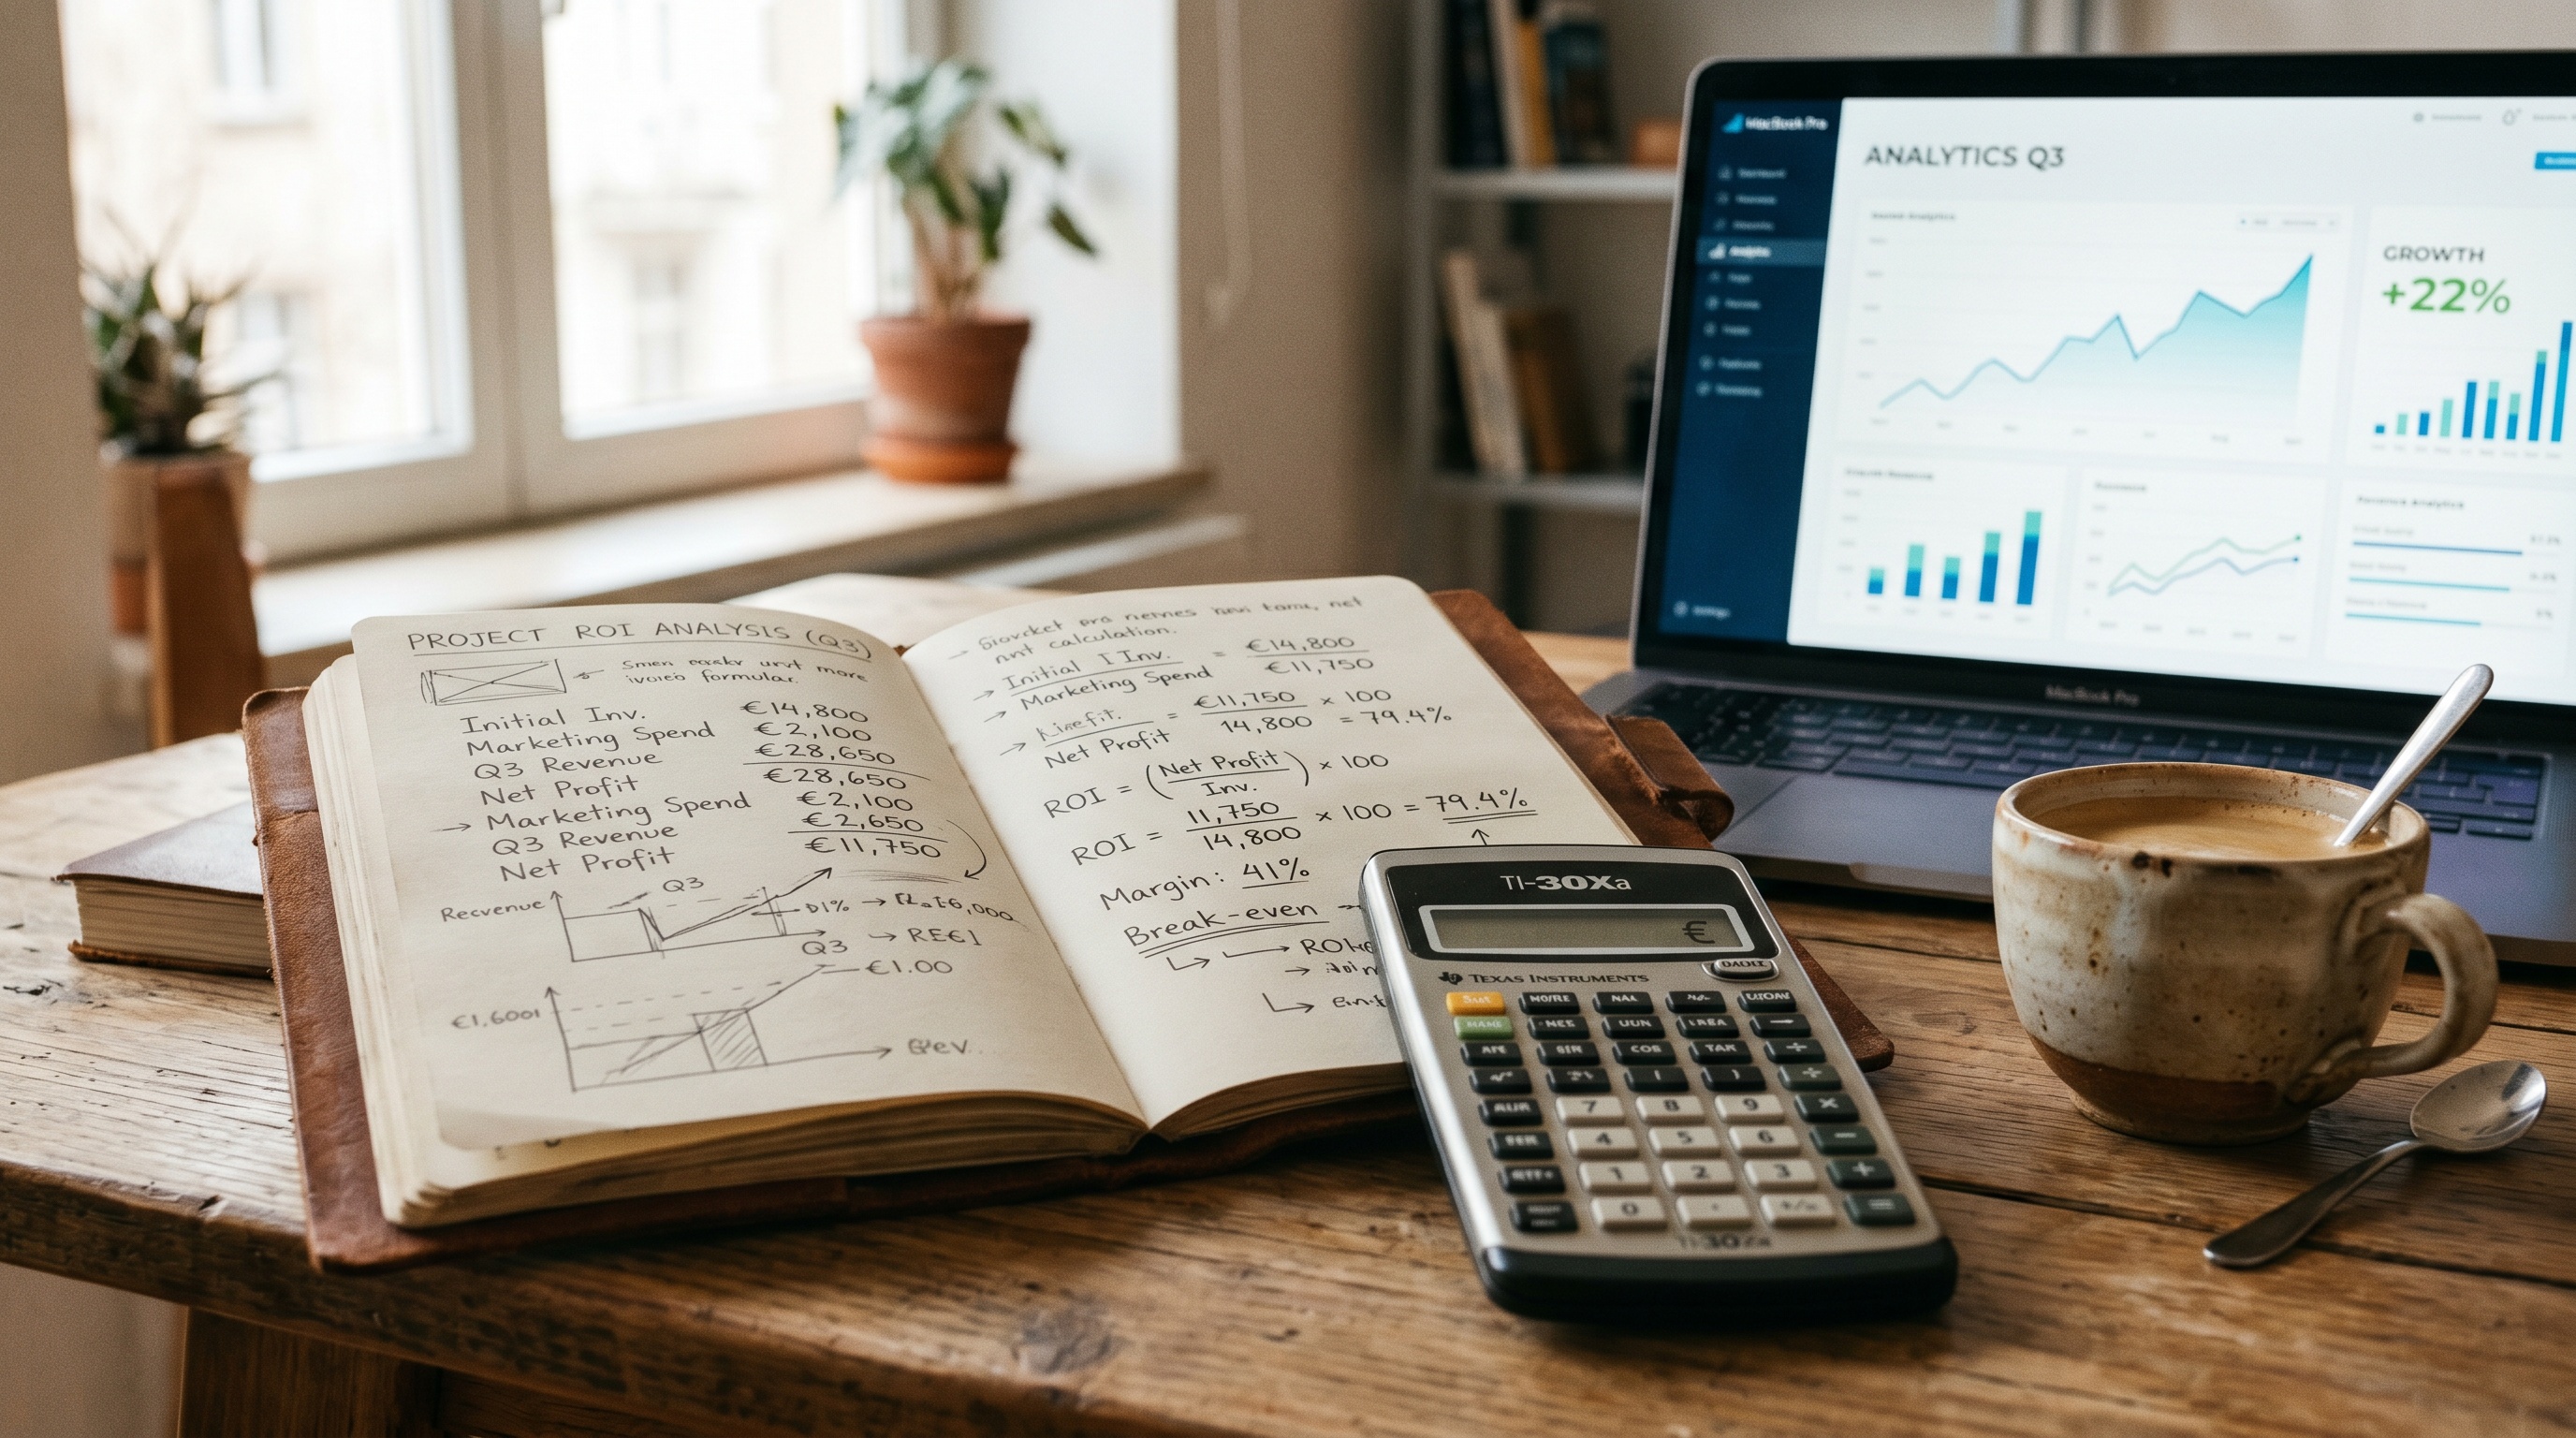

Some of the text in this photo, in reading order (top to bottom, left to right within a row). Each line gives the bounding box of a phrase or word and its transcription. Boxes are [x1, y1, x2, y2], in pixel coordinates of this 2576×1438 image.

[1866, 146, 2064, 170] ANALYTICS Q3
[2383, 245, 2484, 262] GROWTH
[2382, 277, 2510, 314] +22%
[407, 623, 871, 659] PROJECT ROI ANALYSIS (Q3)
[1245, 637, 1354, 653] €14,800
[1003, 660, 1081, 691] Initial
[1117, 649, 1172, 664] Inv.
[1265, 657, 1374, 675] €11,750
[1020, 665, 1214, 711] Marketing Spend
[1193, 691, 1295, 709] €11,750
[1344, 690, 1392, 703] 100
[460, 707, 646, 735] Initial Inv.
[739, 700, 869, 723] €14,800
[1221, 716, 1312, 735] 14,800
[1360, 706, 1453, 726] 79.4%
[467, 721, 715, 756] Marketing Spend
[754, 723, 871, 741] €2,100
[754, 743, 896, 765] €28,650
[1044, 728, 1170, 769] Net Profit
[474, 754, 663, 780] Q3 Revenue
[1210, 750, 1279, 770] Profit
[1341, 755, 1389, 769] 100
[763, 768, 907, 789] €28,650
[1201, 782, 1257, 796] Inv.
[480, 775, 639, 805] Net Profit
[487, 791, 752, 830] Marketing Spend
[797, 791, 914, 812] €2,100
[1044, 787, 1106, 818] ROI
[1187, 801, 1280, 824] 11,750
[1342, 803, 1392, 821] 100
[1426, 787, 1528, 813] 79.4%
[801, 812, 924, 832] €2,650
[492, 826, 679, 856] Q3 Revenue
[804, 837, 942, 858] €11,750
[1071, 832, 1137, 866] ROI
[1203, 827, 1301, 851] 14,800
[500, 845, 676, 882] Net Profit
[663, 876, 704, 892] Q3
[1099, 857, 1310, 911] Margin: 41%
[1500, 875, 1632, 891] TI-30Xa
[1123, 902, 1318, 947] Break-even
[1682, 920, 1716, 945] €
[801, 940, 848, 956] Q3
[865, 960, 953, 975] €1.00
[1469, 974, 1649, 984] TEXAS INSTRUMENTS
[1582, 1100, 1597, 1112] 7
[1663, 1098, 1680, 1112] 8
[1742, 1097, 1759, 1111] 9
[1596, 1132, 1612, 1145] 4
[1677, 1130, 1693, 1144] 5
[1757, 1129, 1775, 1143] 6
[1609, 1167, 1623, 1181] 1
[1691, 1165, 1708, 1180] 2
[1775, 1164, 1791, 1179] 3
